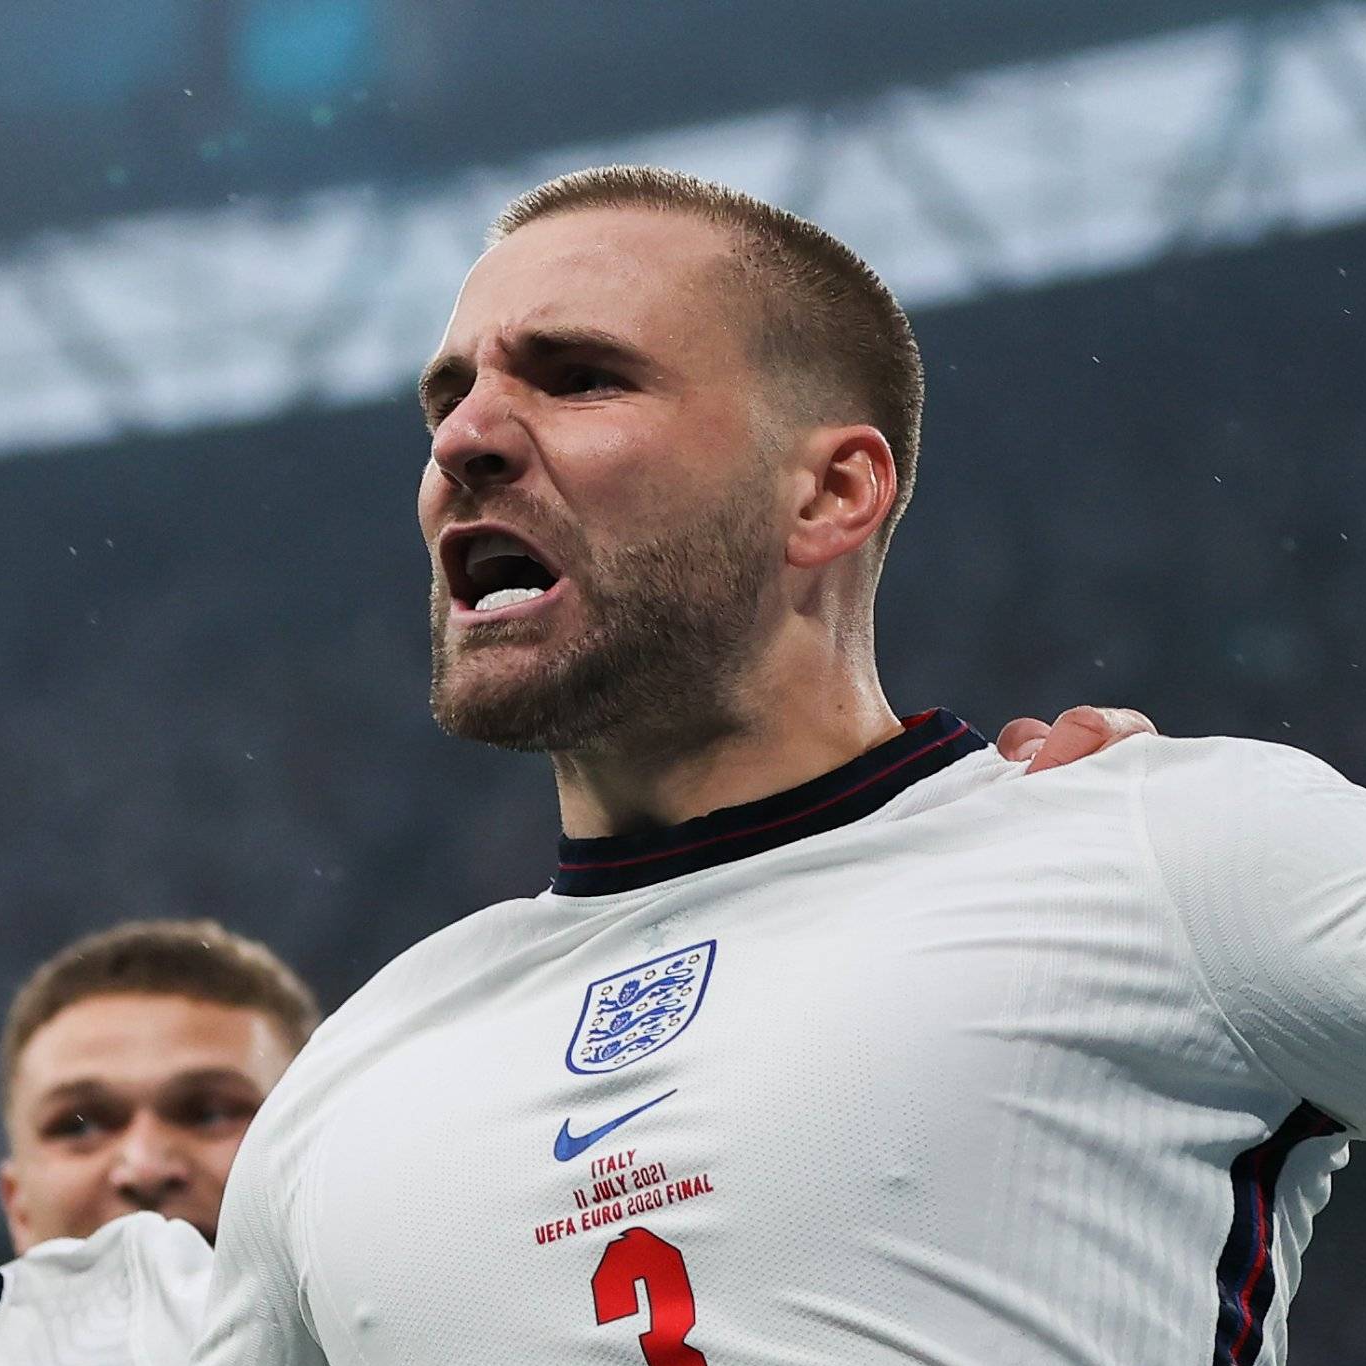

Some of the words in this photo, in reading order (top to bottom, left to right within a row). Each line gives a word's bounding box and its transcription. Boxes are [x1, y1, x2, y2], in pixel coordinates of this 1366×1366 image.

[573, 1188, 588, 1210] 11
[592, 1174, 629, 1204] JULY
[631, 1162, 668, 1190] 2021
[591, 1148, 637, 1179] ITALY
[535, 1217, 577, 1246] UEFA
[581, 1201, 623, 1232] EURO
[627, 1188, 664, 1216] 2020
[666, 1173, 715, 1205] FINAL
